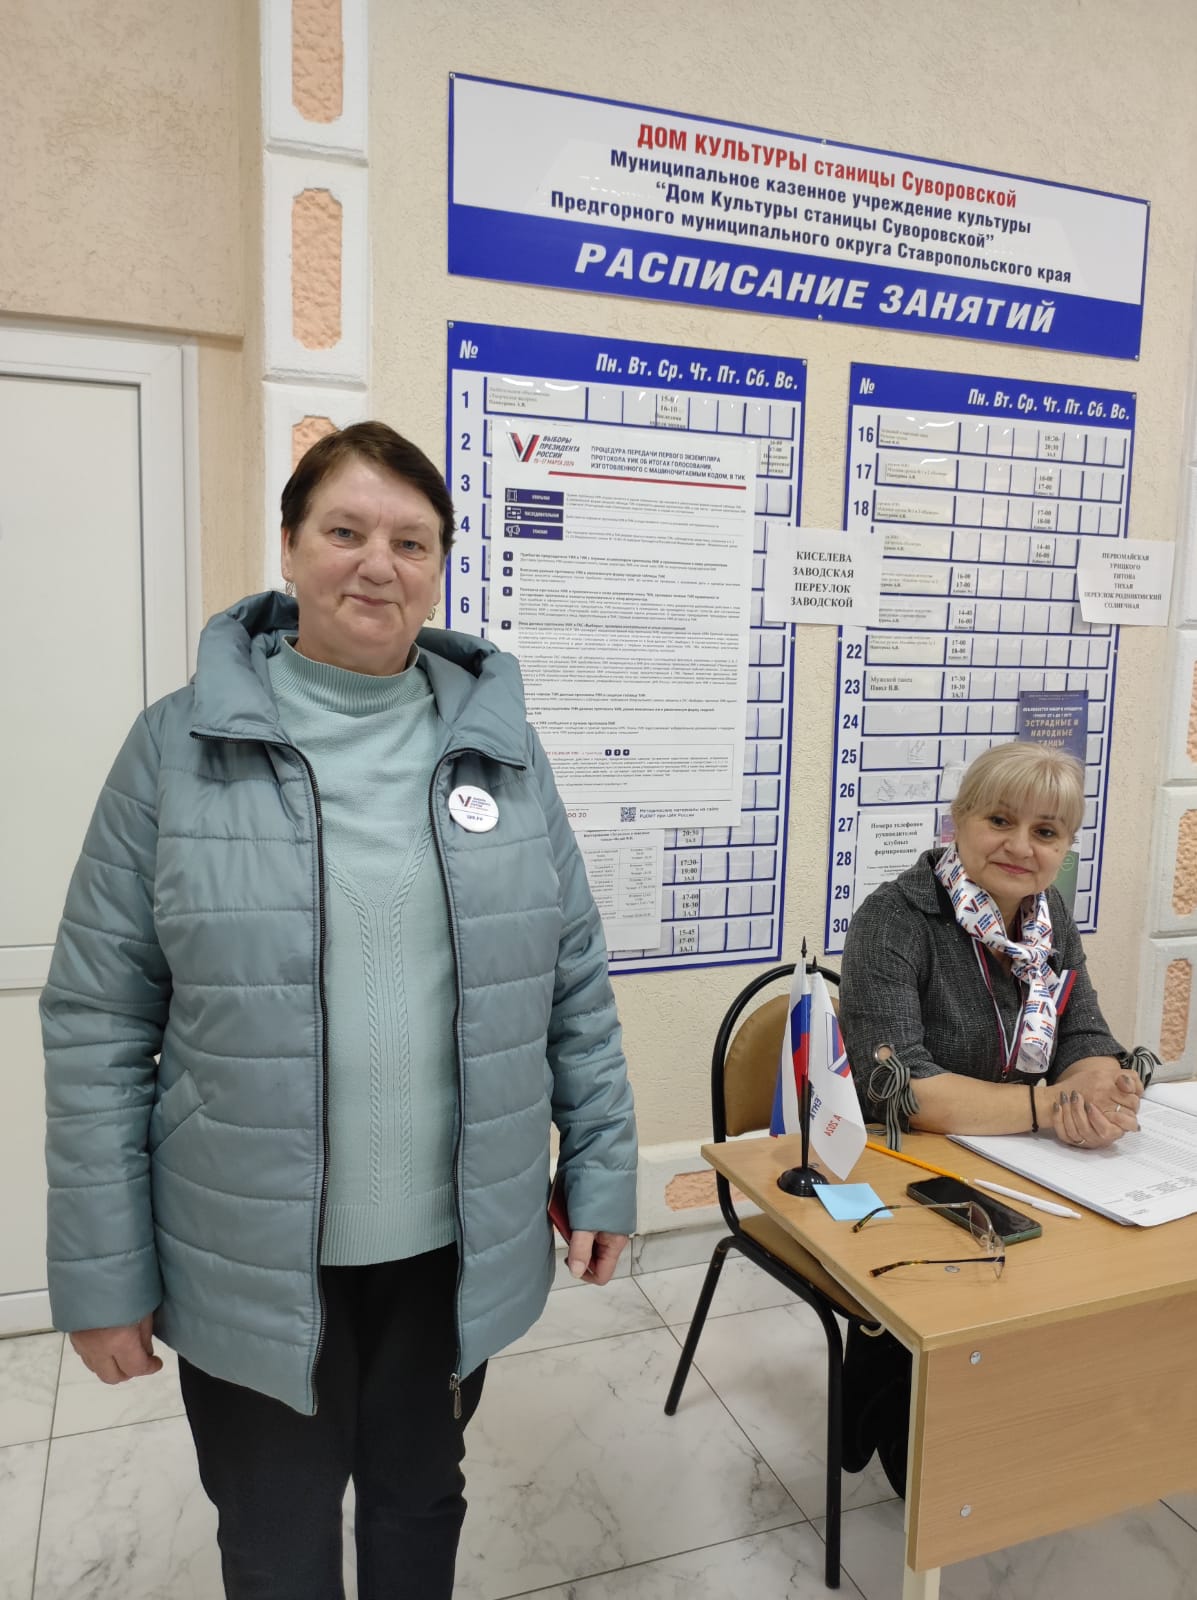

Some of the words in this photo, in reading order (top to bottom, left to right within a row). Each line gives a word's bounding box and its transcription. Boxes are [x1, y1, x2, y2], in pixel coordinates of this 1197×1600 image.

[637, 123, 687, 151] ДОМ
[695, 133, 807, 173] КУЛЬТУРЫ
[814, 159, 895, 188] станицы
[902, 171, 1017, 208] Суворовской
[610, 150, 760, 189] Муниципальное
[766, 178, 846, 203] казенное
[852, 192, 952, 221] учреждение
[957, 205, 1031, 234] культуры
[711, 190, 797, 219] Культуры
[804, 204, 877, 232] станицы
[882, 217, 994, 248] Суворовской”
[551, 190, 674, 224] Предгорного
[681, 213, 829, 247] муниципального
[836, 236, 892, 256] округа
[897, 242, 1033, 277] Ставропольского
[1037, 267, 1072, 284] края
[574, 242, 869, 309] РАСПИСАНИЕ
[879, 284, 1057, 333] ЗАНЯТИЙ
[459, 339, 479, 359] №
[596, 353, 622, 373] Пн.
[628, 356, 652, 376] Вт.
[657, 359, 683, 382] Ср.
[690, 362, 712, 382] Чт.
[717, 365, 740, 384] Пт.
[745, 368, 769, 387] Сб.
[775, 371, 798, 390] Вс.
[859, 377, 875, 394] №
[461, 391, 469, 408] 1
[968, 388, 989, 406] Пн.
[993, 391, 1013, 409] Вт.
[1017, 393, 1037, 414] Ср.
[1043, 396, 1061, 413] Чт.
[1064, 399, 1083, 416] Пт.
[1087, 400, 1106, 418] Сб.
[1110, 403, 1129, 420] Вс.
[461, 432, 471, 450] 2
[858, 426, 874, 443] 16
[591, 446, 626, 454] ПРОЦЕДУРА
[627, 449, 658, 457] ПЕРЕДАЧИ
[591, 454, 626, 462] ПРОТОКОЛА
[591, 463, 643, 472] ИЗГОТОВЛЕННОГО
[856, 463, 872, 479] 17
[461, 474, 471, 492] 3
[854, 500, 869, 516] 18
[461, 516, 470, 533] 4
[796, 551, 853, 563] КИСЕЛЕВА
[1102, 552, 1150, 561] ПЕРВОМАЙСКАЯ
[461, 556, 470, 574] 5
[792, 566, 855, 579] ЗАВОДСКАЯ
[794, 582, 851, 594] ПЕРЕУЛОК
[461, 597, 470, 614] 6
[790, 596, 854, 608] ЗАВОДСКОЙ
[846, 644, 862, 659] 22
[844, 680, 860, 694] 23
[843, 714, 859, 729] 24
[1024, 719, 1072, 728] ЭСТРАДНЫЕ
[1031, 729, 1073, 738] НАРОДНЫЕ
[842, 749, 857, 764] 25
[840, 783, 855, 798] 26
[838, 818, 854, 832] 27
[836, 852, 852, 866] 28
[835, 885, 850, 900] 29
[833, 918, 849, 933] 30
